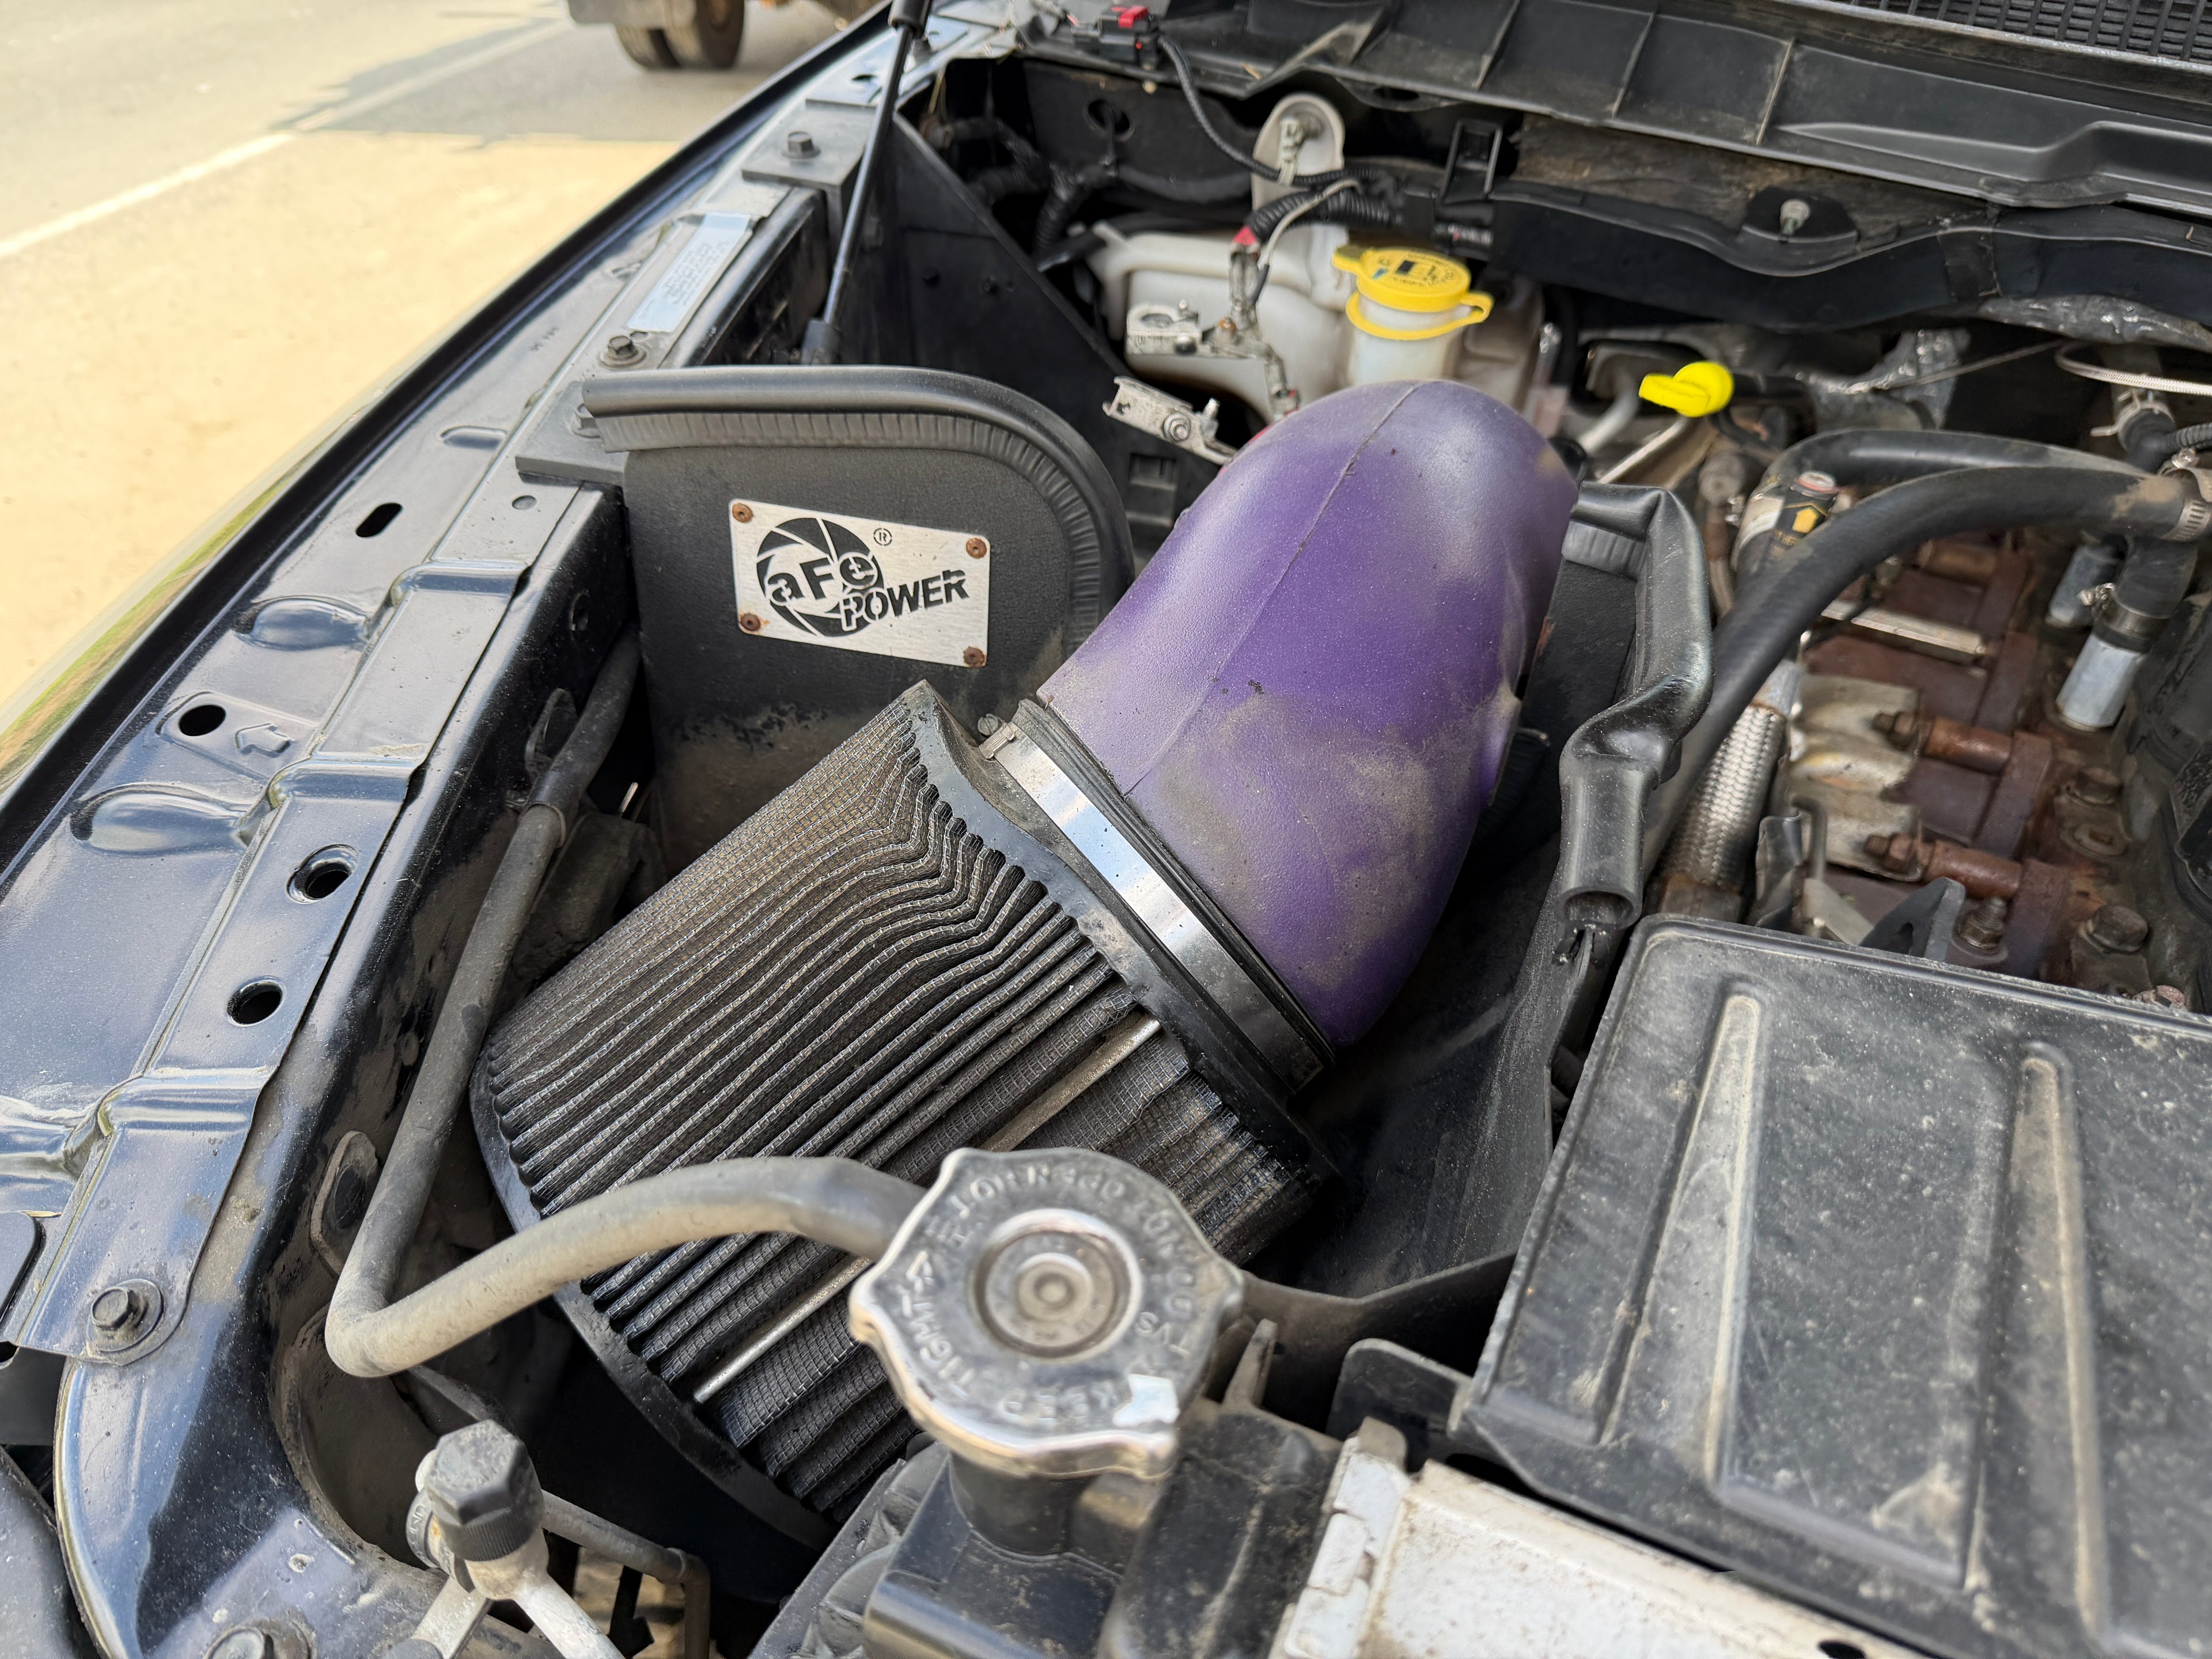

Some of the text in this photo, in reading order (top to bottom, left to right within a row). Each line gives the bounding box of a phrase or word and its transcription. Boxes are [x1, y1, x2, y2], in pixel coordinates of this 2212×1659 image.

[767, 554, 876, 604] aFe
[843, 569, 969, 630] POWER
[1135, 1312, 1191, 1356] TVS
[997, 1381, 1118, 1426] KEEP
